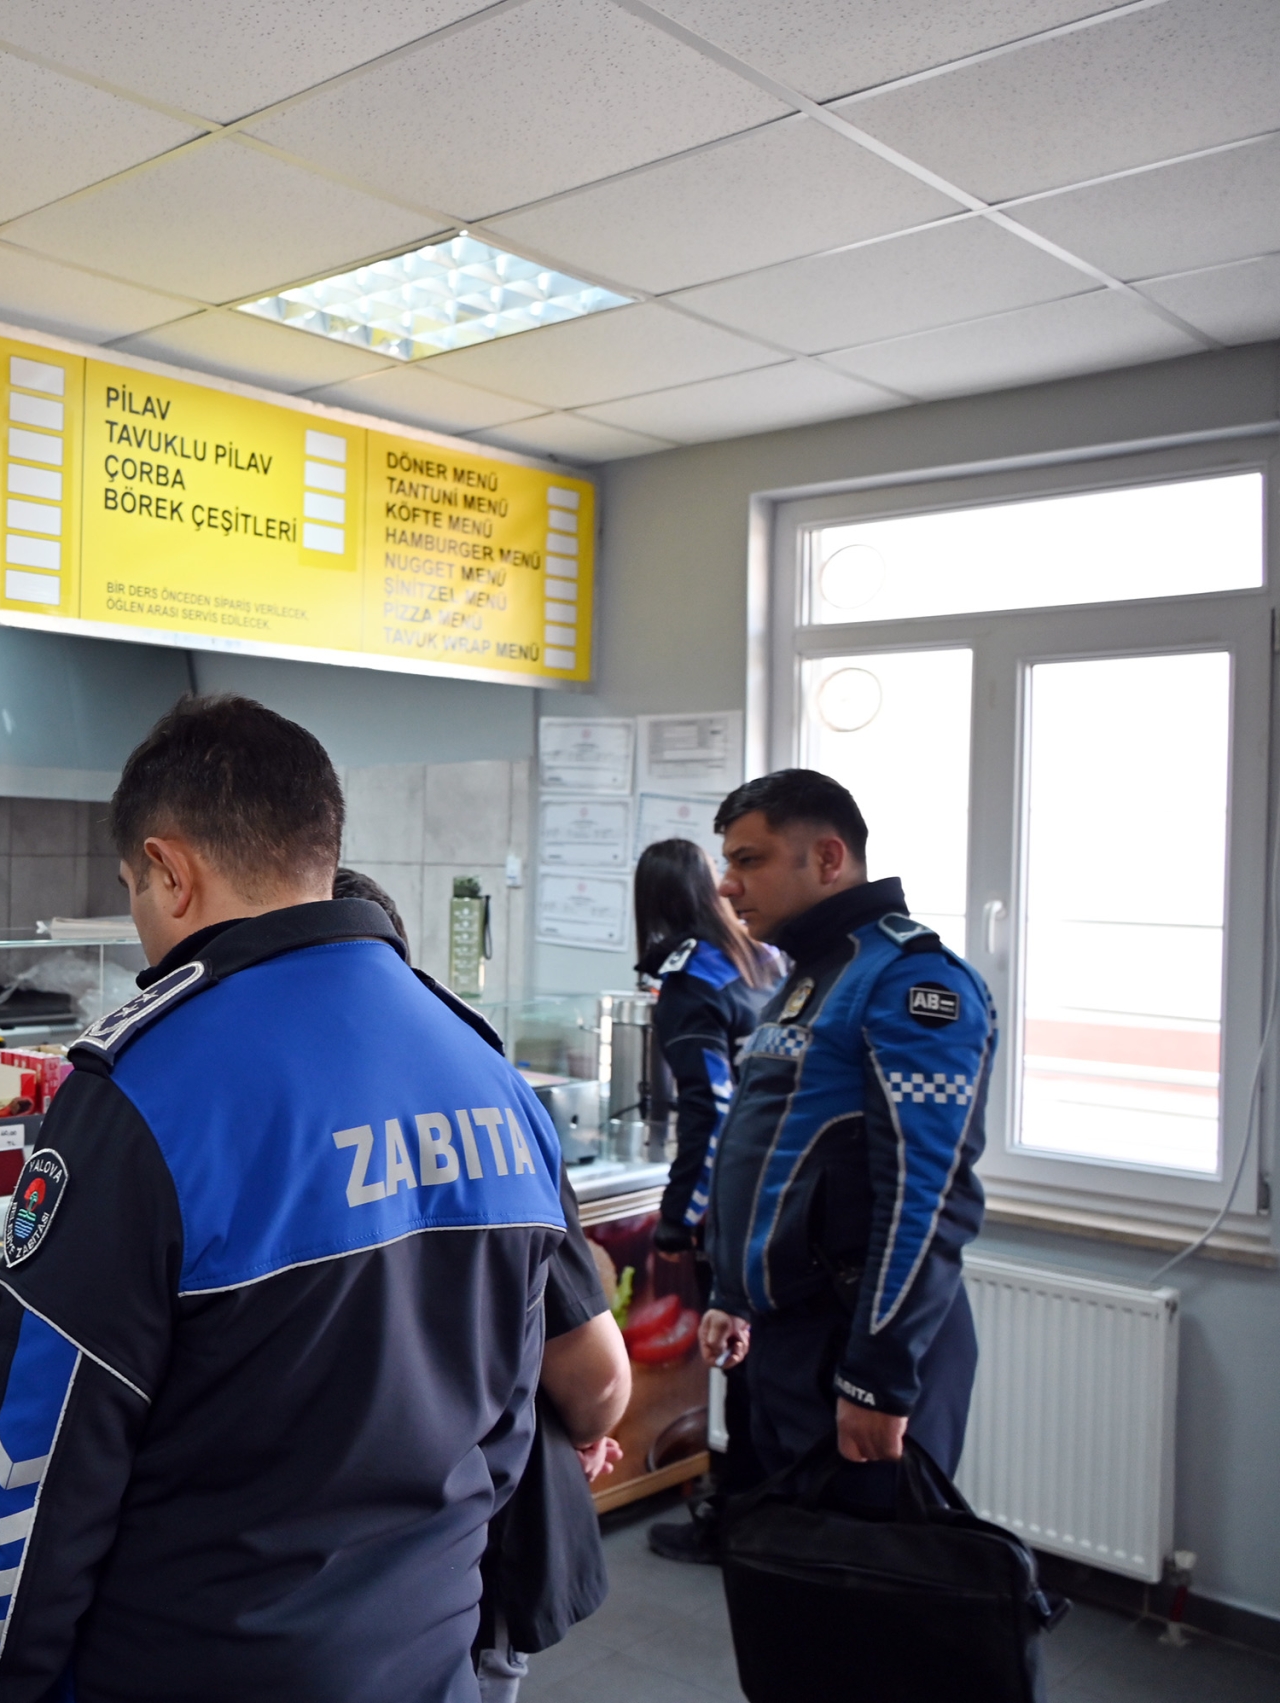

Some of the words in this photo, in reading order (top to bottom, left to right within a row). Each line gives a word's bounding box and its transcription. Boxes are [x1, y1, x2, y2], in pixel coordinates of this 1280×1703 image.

[106, 386, 171, 421] PİLAV
[104, 419, 207, 462] TAVUKLU
[214, 443, 273, 476] PİLAV
[104, 454, 186, 490] ÇORBA
[387, 451, 447, 480] DÖNER
[453, 467, 498, 492] MENÜ
[104, 487, 184, 523] BÖREK
[191, 504, 297, 543] ÇEŞİTLERİ
[387, 476, 458, 507] TANTUNİ
[463, 494, 508, 518] MENÜ
[386, 501, 443, 528] KÖFTE
[448, 514, 493, 539] MENÜ
[385, 527, 494, 561] HAMBURGER
[499, 547, 541, 570] MENÜ
[385, 552, 455, 579] NUGGET
[461, 565, 507, 587] MENÜ
[129, 585, 157, 599] DERS
[162, 587, 210, 606] ÖNCEDEN
[147, 604, 179, 618] ARASI
[29, 1160, 63, 1183] YALOVA
[333, 1107, 536, 1208] ZABITA
[15, 1212, 50, 1259] ZABITASI
